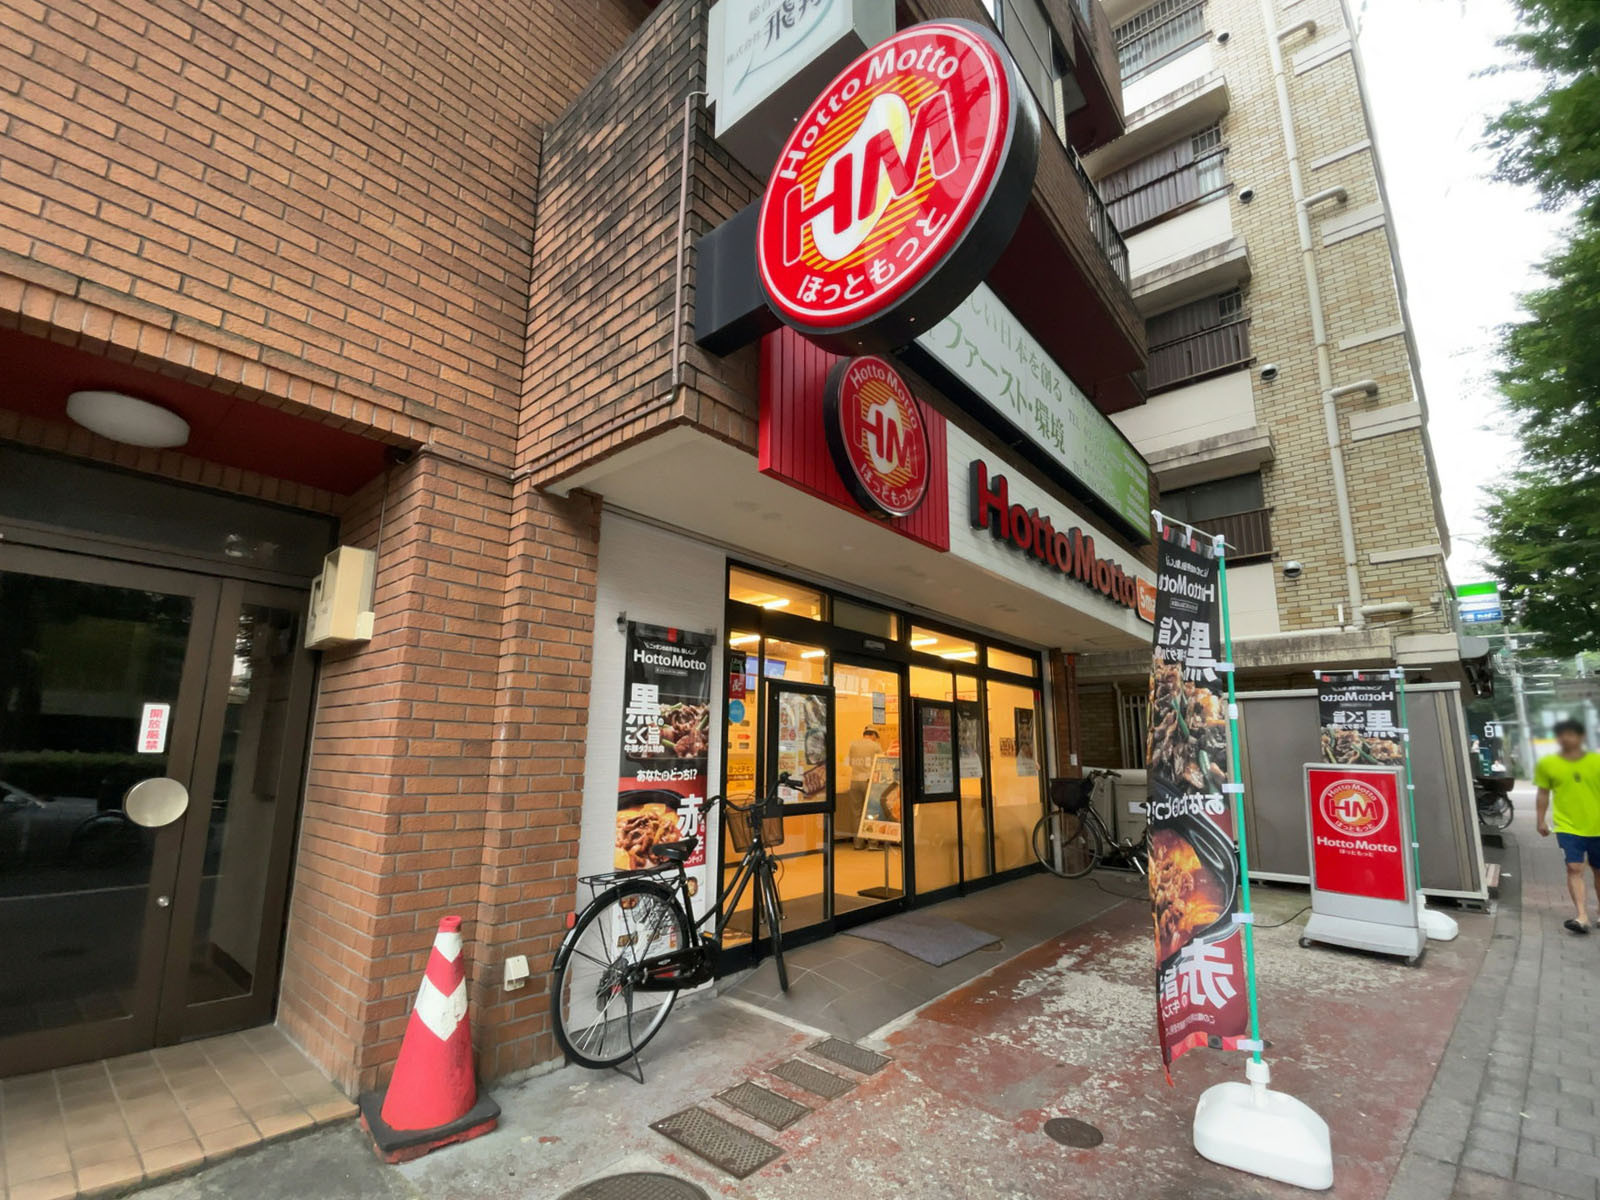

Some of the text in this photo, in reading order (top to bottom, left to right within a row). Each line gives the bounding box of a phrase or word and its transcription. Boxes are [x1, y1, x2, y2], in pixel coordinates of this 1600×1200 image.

[783, 89, 960, 267] HM
[796, 207, 947, 305] ほっともっと
[853, 394, 918, 479] HM
[860, 462, 914, 506] ほっともっと
[1329, 798, 1378, 820] HM
[1335, 820, 1374, 833] ほっともっと
